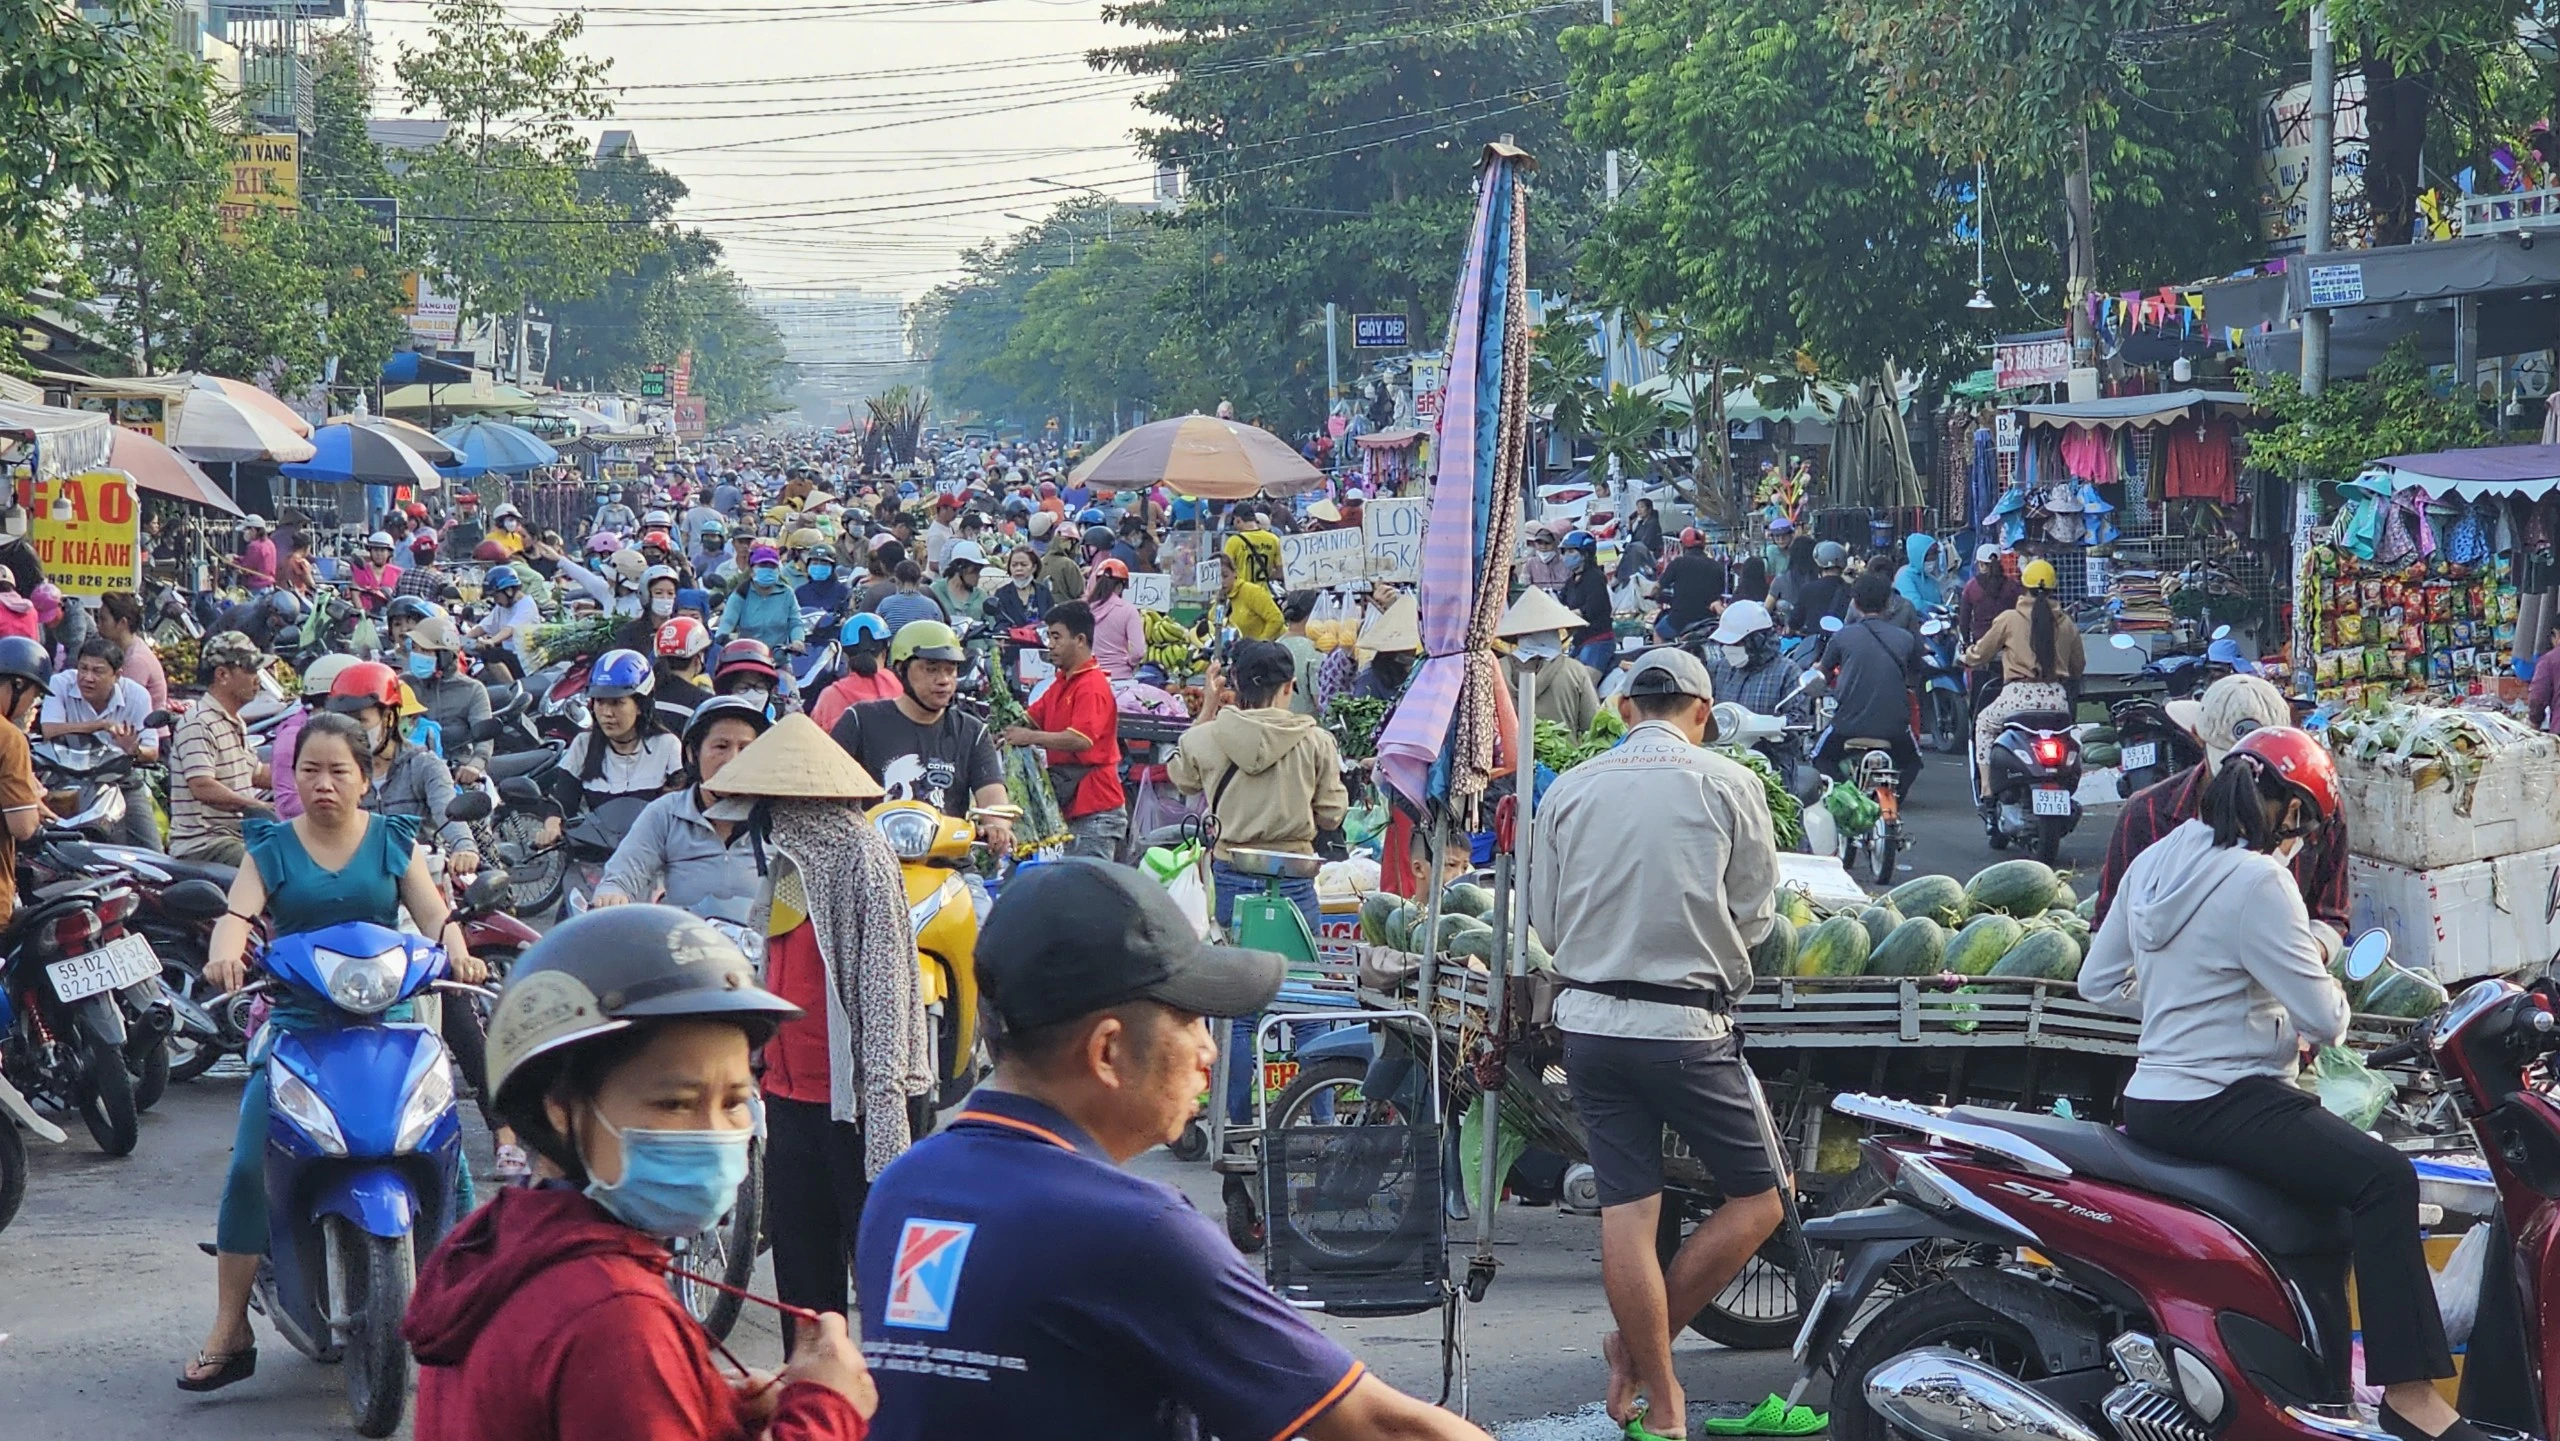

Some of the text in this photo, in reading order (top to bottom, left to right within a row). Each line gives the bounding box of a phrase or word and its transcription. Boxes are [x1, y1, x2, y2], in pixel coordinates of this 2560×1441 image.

[256, 139, 291, 161] VÀNG
[18, 478, 132, 530] GẠO
[62, 537, 131, 568] KHÁNH
[1283, 537, 1306, 577] 2
[78, 575, 101, 588] 826
[107, 576, 132, 588] 263
[1630, 754, 1658, 764] Pool
[1659, 754, 1667, 763] &
[1670, 755, 1693, 765] Spa
[2039, 791, 2065, 803] 59-F2
[58, 954, 105, 980] 59-D2
[60, 969, 117, 998] 922.21
[2068, 1204, 2113, 1223] mode
